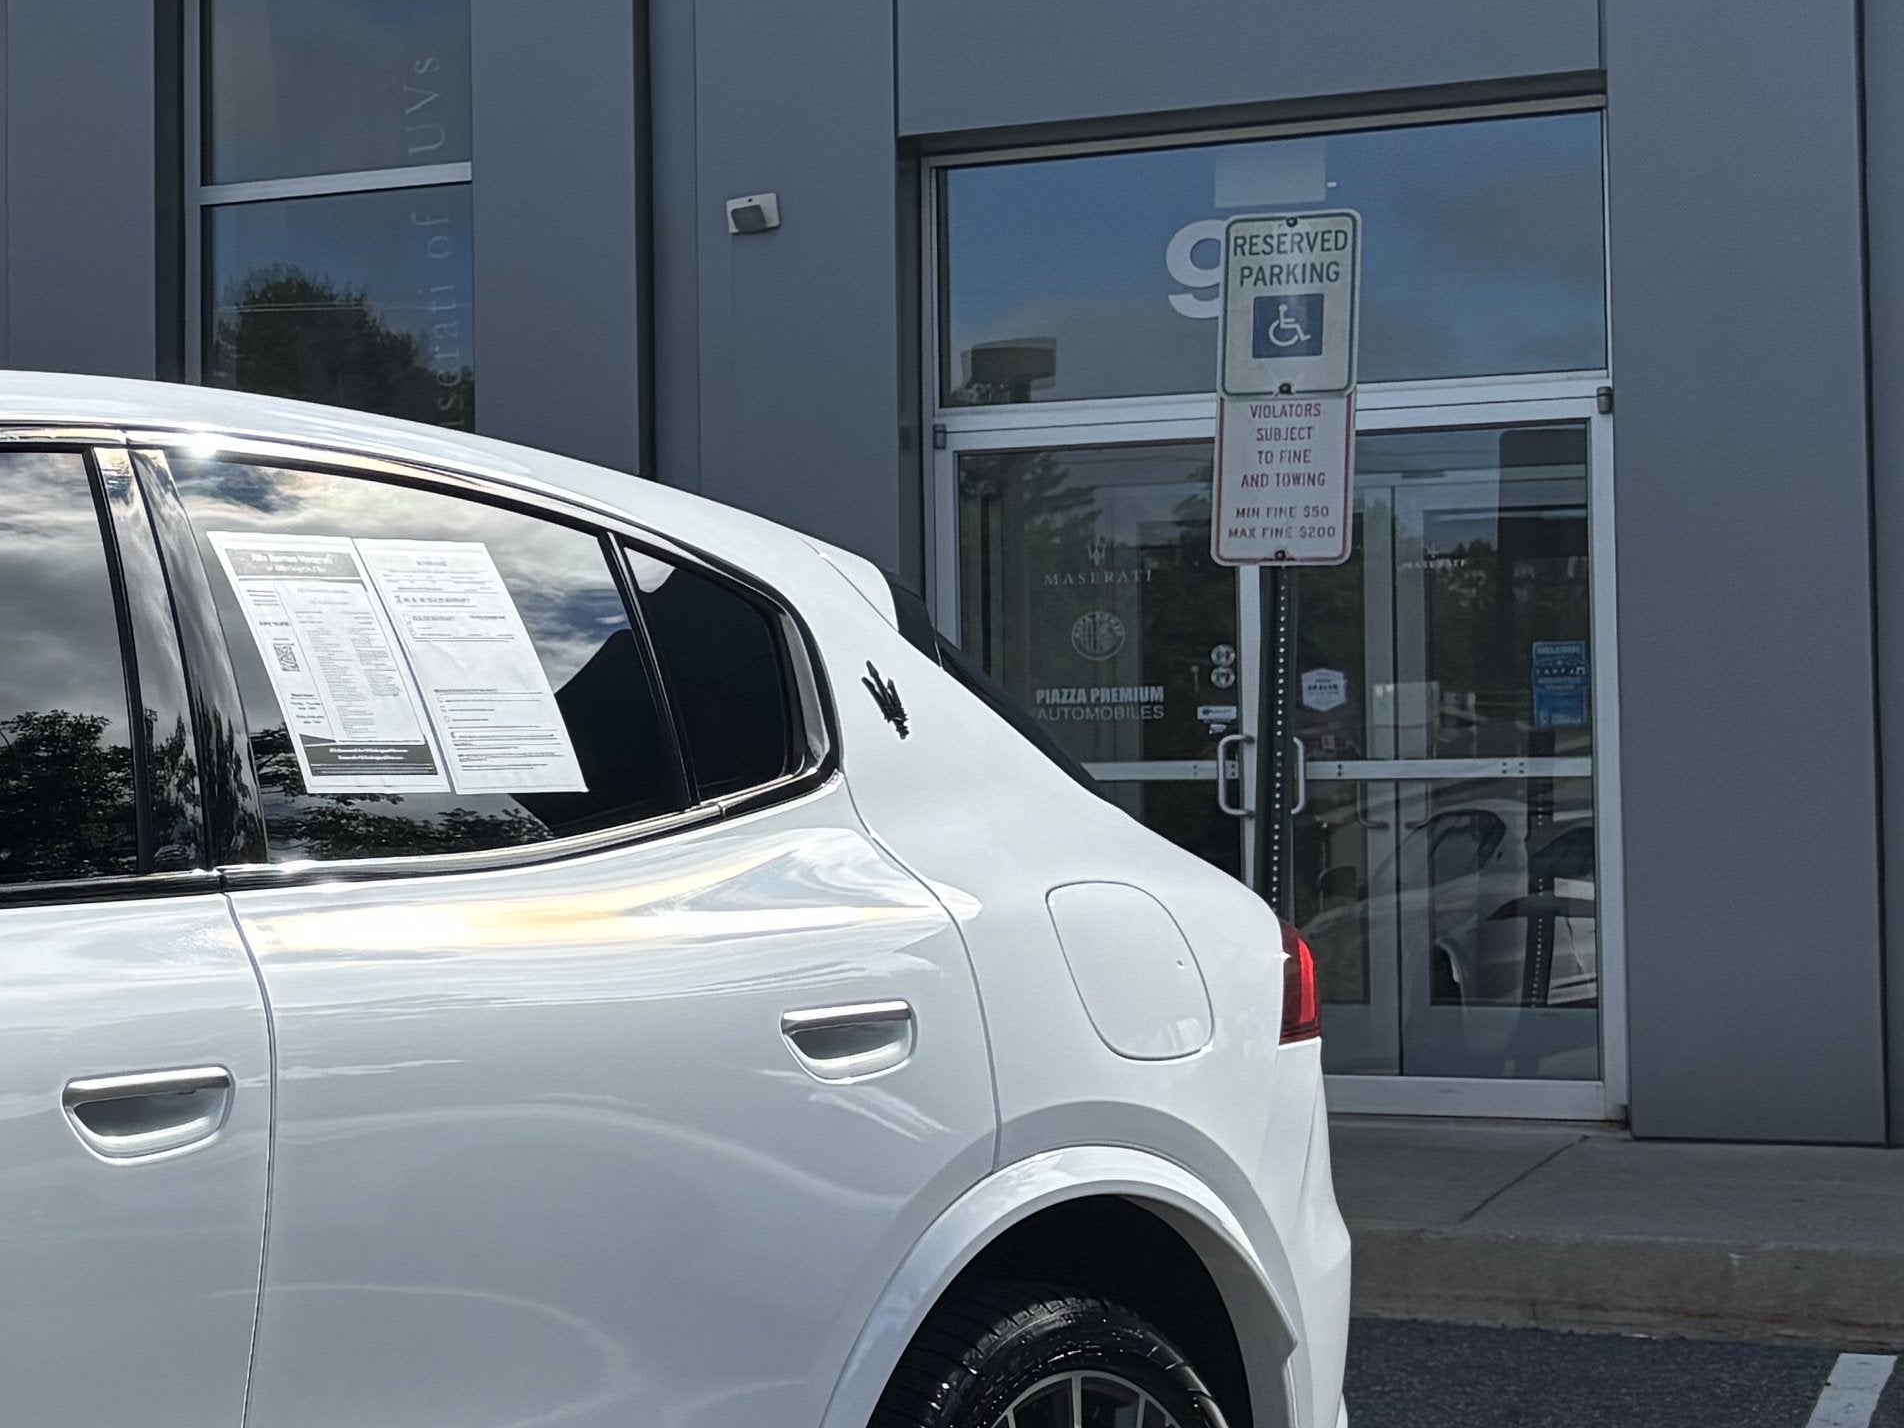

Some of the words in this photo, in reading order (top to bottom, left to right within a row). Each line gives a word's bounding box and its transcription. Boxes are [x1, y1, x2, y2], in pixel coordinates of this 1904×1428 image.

[1233, 230, 1348, 257] RESERVED
[1240, 262, 1340, 287] PARKING
[1249, 403, 1322, 419] VIOLATORS
[1256, 426, 1313, 441] SUBJECT
[1257, 450, 1273, 464] TO
[1279, 449, 1311, 464] FINE
[1241, 473, 1269, 488] AND
[1275, 472, 1326, 487] TOWING
[1236, 507, 1260, 518] MIN
[1266, 506, 1296, 518] FINE
[1303, 504, 1329, 518] $50
[1228, 527, 1256, 539] MAX
[1262, 526, 1292, 539] FINE
[1299, 525, 1336, 539] $200
[1043, 569, 1152, 586] MASERATI
[1036, 687, 1087, 704] PIAZZA
[1090, 686, 1164, 703] PREMIUM
[1037, 705, 1164, 721] AUTOMOBILES
